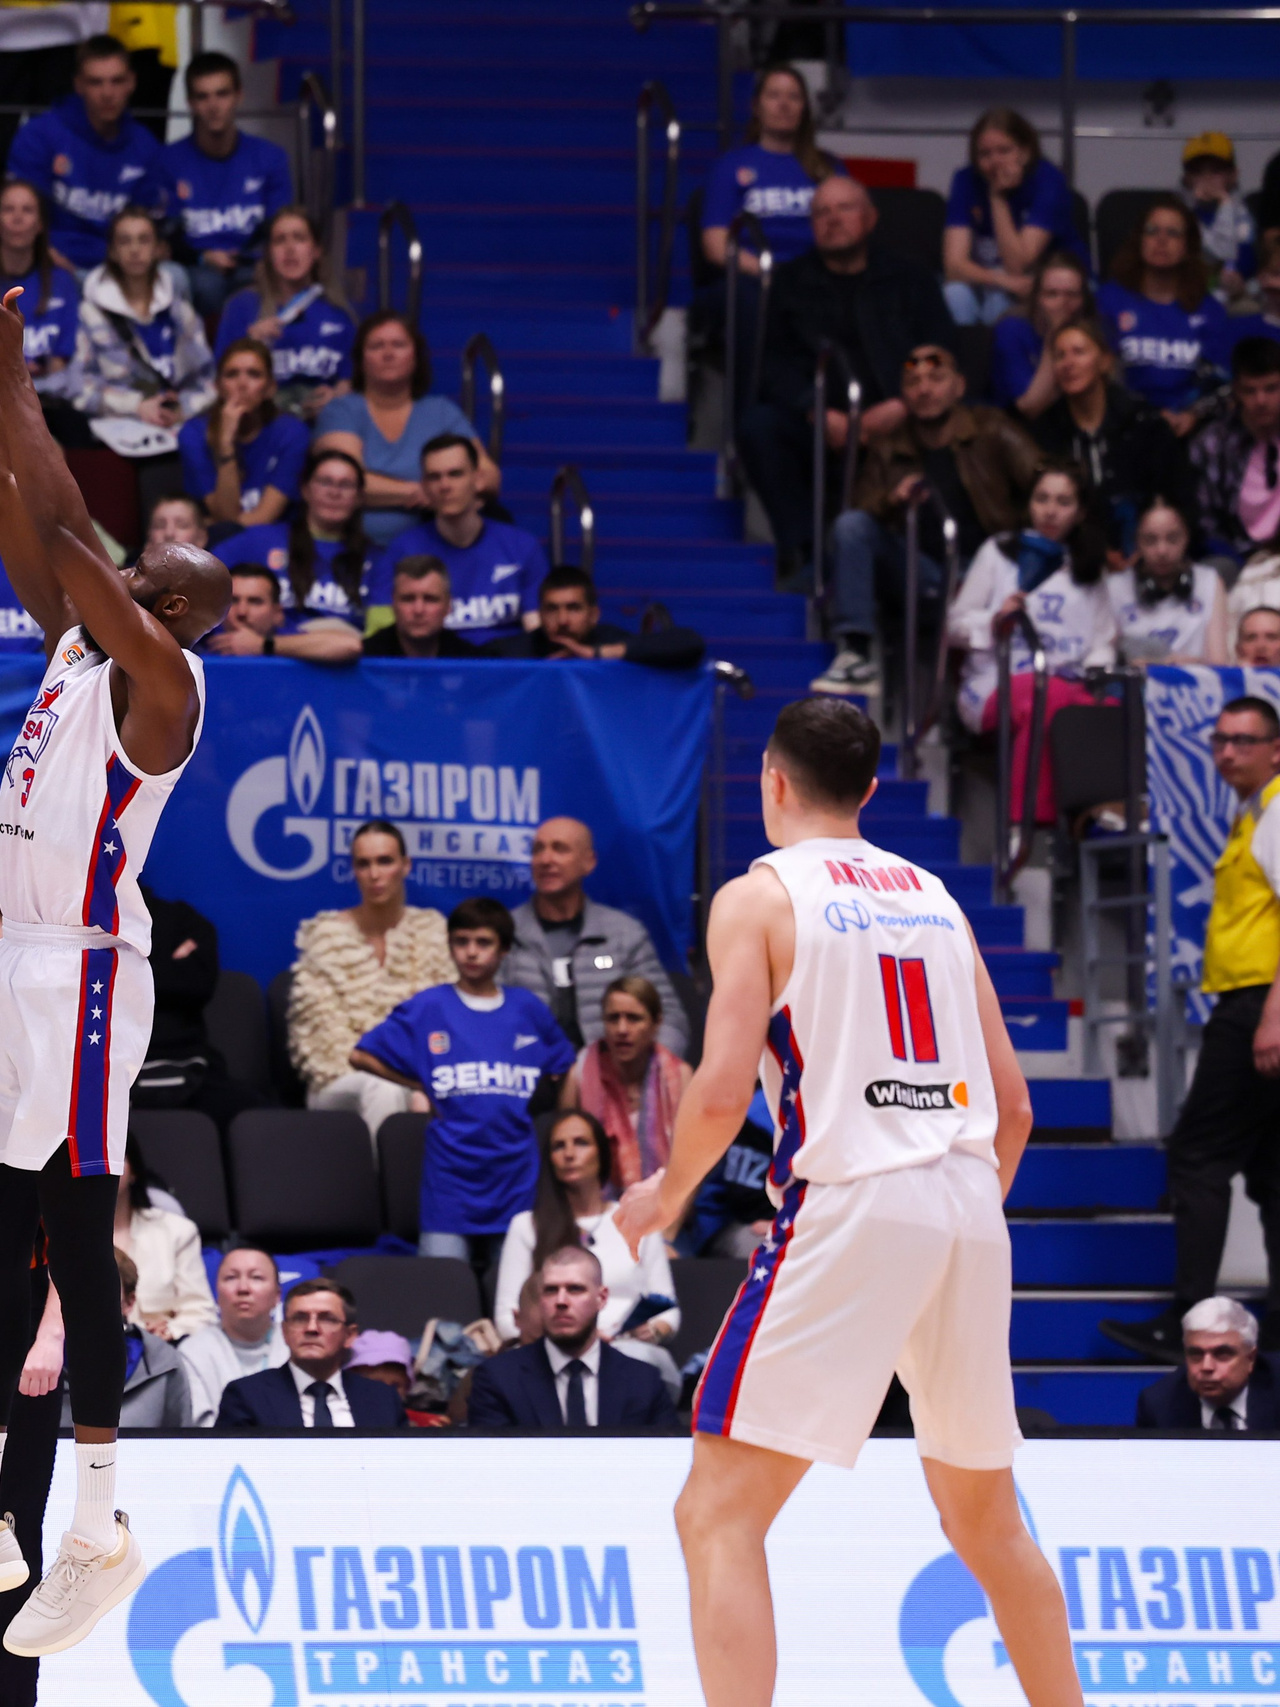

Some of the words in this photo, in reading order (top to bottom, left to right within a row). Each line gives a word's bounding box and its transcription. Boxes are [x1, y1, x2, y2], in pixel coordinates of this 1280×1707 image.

[20, 767, 35, 808] 3
[334, 758, 540, 823] ГАЗПРОМ
[341, 826, 537, 857] ТНСГАЗ
[878, 953, 939, 1063] 11
[431, 1061, 541, 1093] ЗЕНИТ
[292, 1546, 637, 1631] ГАЗПРОМ
[1058, 1547, 1280, 1630] ГАЗПР
[313, 1648, 635, 1685] ТРАНСГАЗ
[1081, 1651, 1277, 1686] ТРАНС
